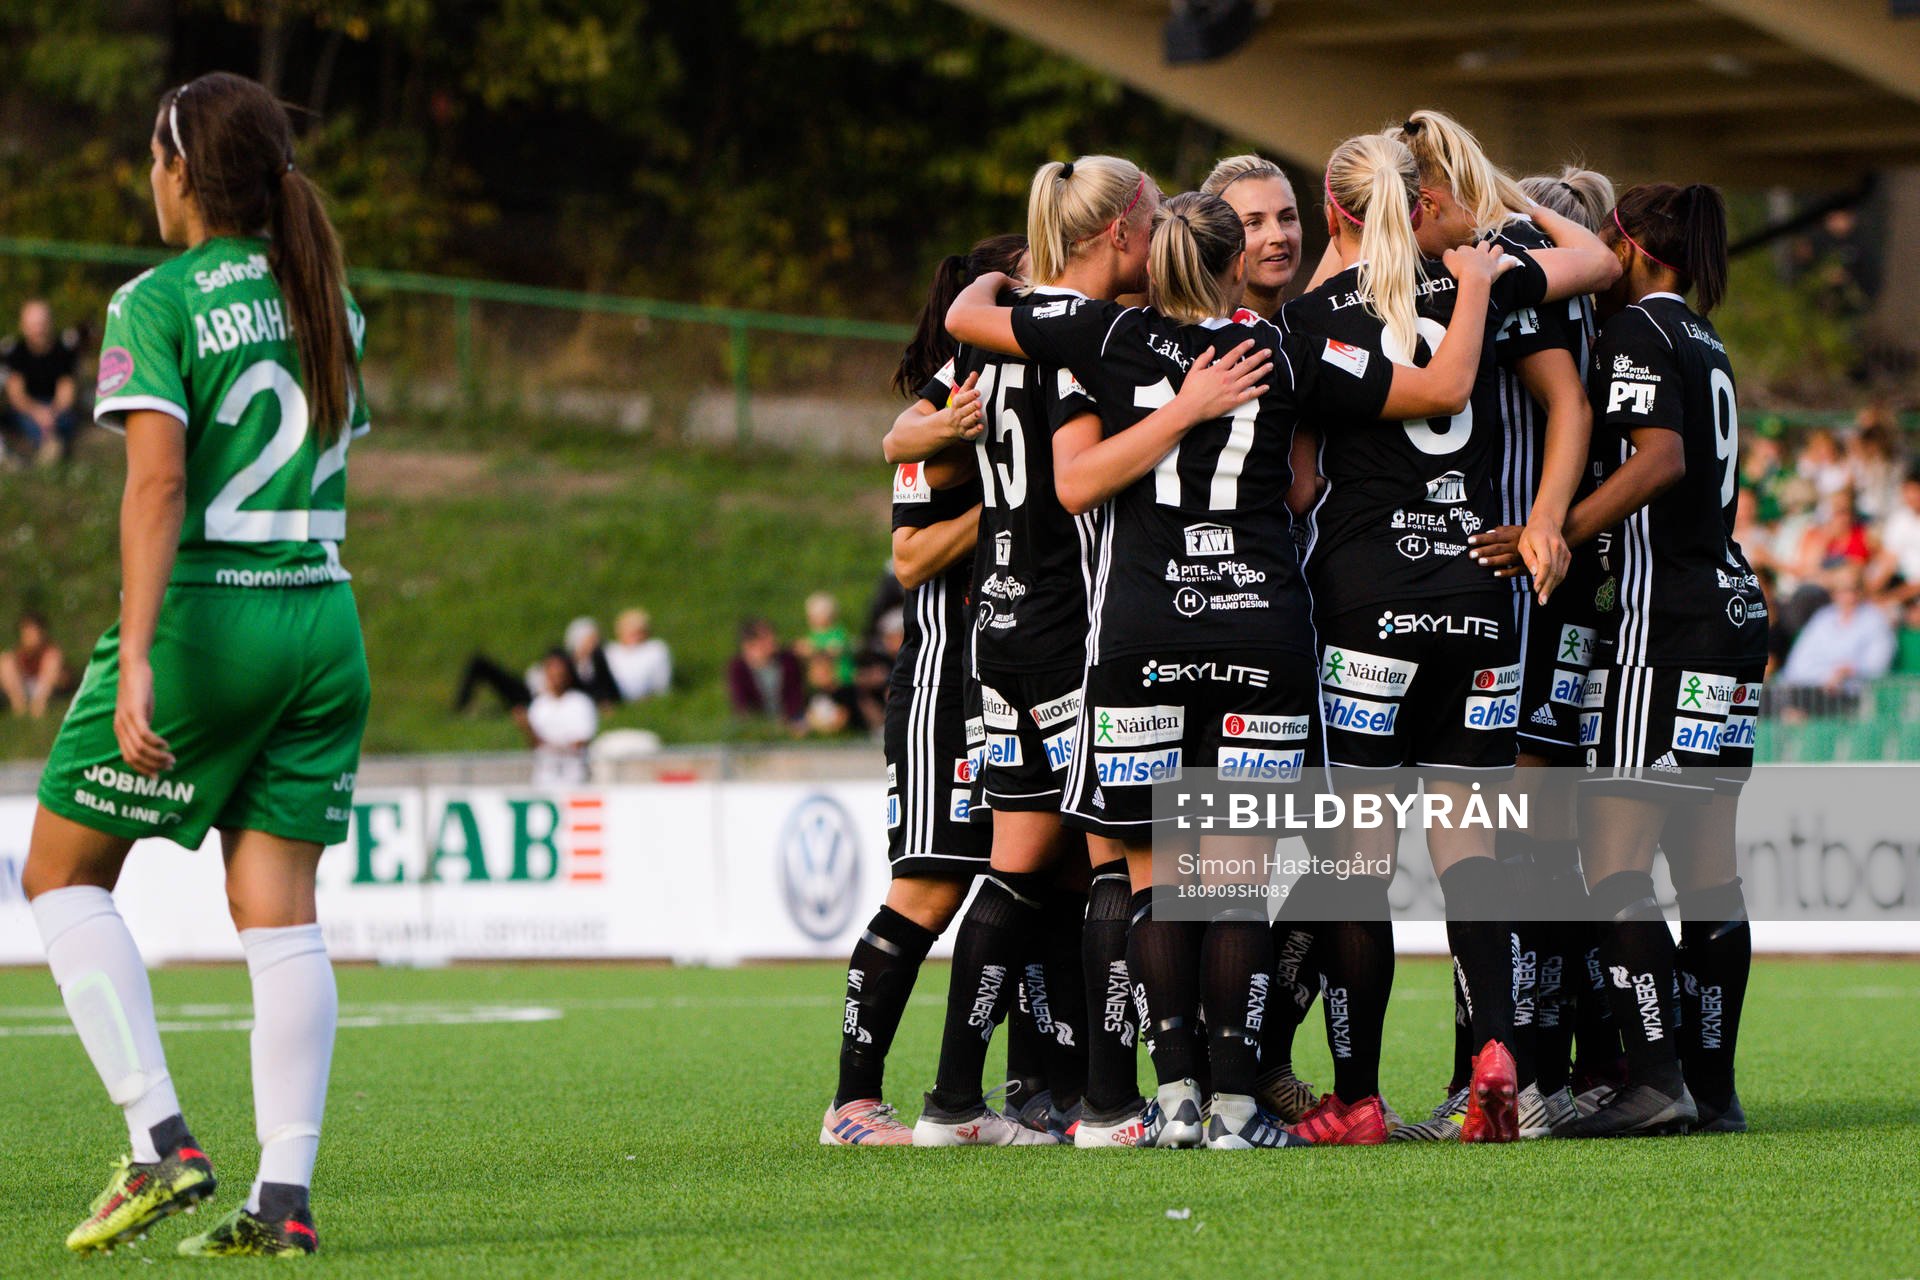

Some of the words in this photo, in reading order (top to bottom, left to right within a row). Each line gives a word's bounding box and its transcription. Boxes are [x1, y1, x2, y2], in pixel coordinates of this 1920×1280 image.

[1606, 381, 1656, 415] PT
[975, 363, 1027, 510] 15
[1134, 375, 1260, 510] 17
[1711, 367, 1739, 509] 9
[1186, 533, 1234, 552] RAWI
[1434, 542, 1467, 551] HELIKOP
[1218, 561, 1247, 575] Pite
[1184, 594, 1196, 608] H
[1210, 593, 1260, 602] HELIKOPTER
[1210, 602, 1239, 610] BRAND
[1240, 600, 1270, 609] DESIGN
[1394, 613, 1499, 640] SKYLITE
[1158, 662, 1270, 688] SKYLITE
[1039, 698, 1080, 722] AllOffic
[1324, 698, 1396, 732] ahlsell
[1469, 698, 1517, 726] ahls
[1531, 715, 1558, 727] adidas
[1247, 721, 1308, 735] AllOffice
[1677, 723, 1722, 752] ahls
[1098, 751, 1179, 783] ahlsell
[1221, 752, 1303, 780] ahlsell
[1586, 748, 1597, 773] 9
[1651, 763, 1682, 774] adidas
[84, 765, 195, 804] JOBMAN
[74, 788, 117, 816] SILJA
[122, 804, 161, 825] LINE
[350, 799, 559, 885] EAB
[843, 968, 865, 1037] WINERS
[968, 964, 1007, 1028] WIXNERS
[1025, 963, 1055, 1034] WIXNERS
[1104, 959, 1130, 1032] WIXNERS
[1539, 955, 1563, 1027] WINERS
[1631, 971, 1664, 1042] WIXNERS
[1329, 987, 1352, 1058] WIXNERS
[1700, 985, 1722, 1049] WIXNERS
